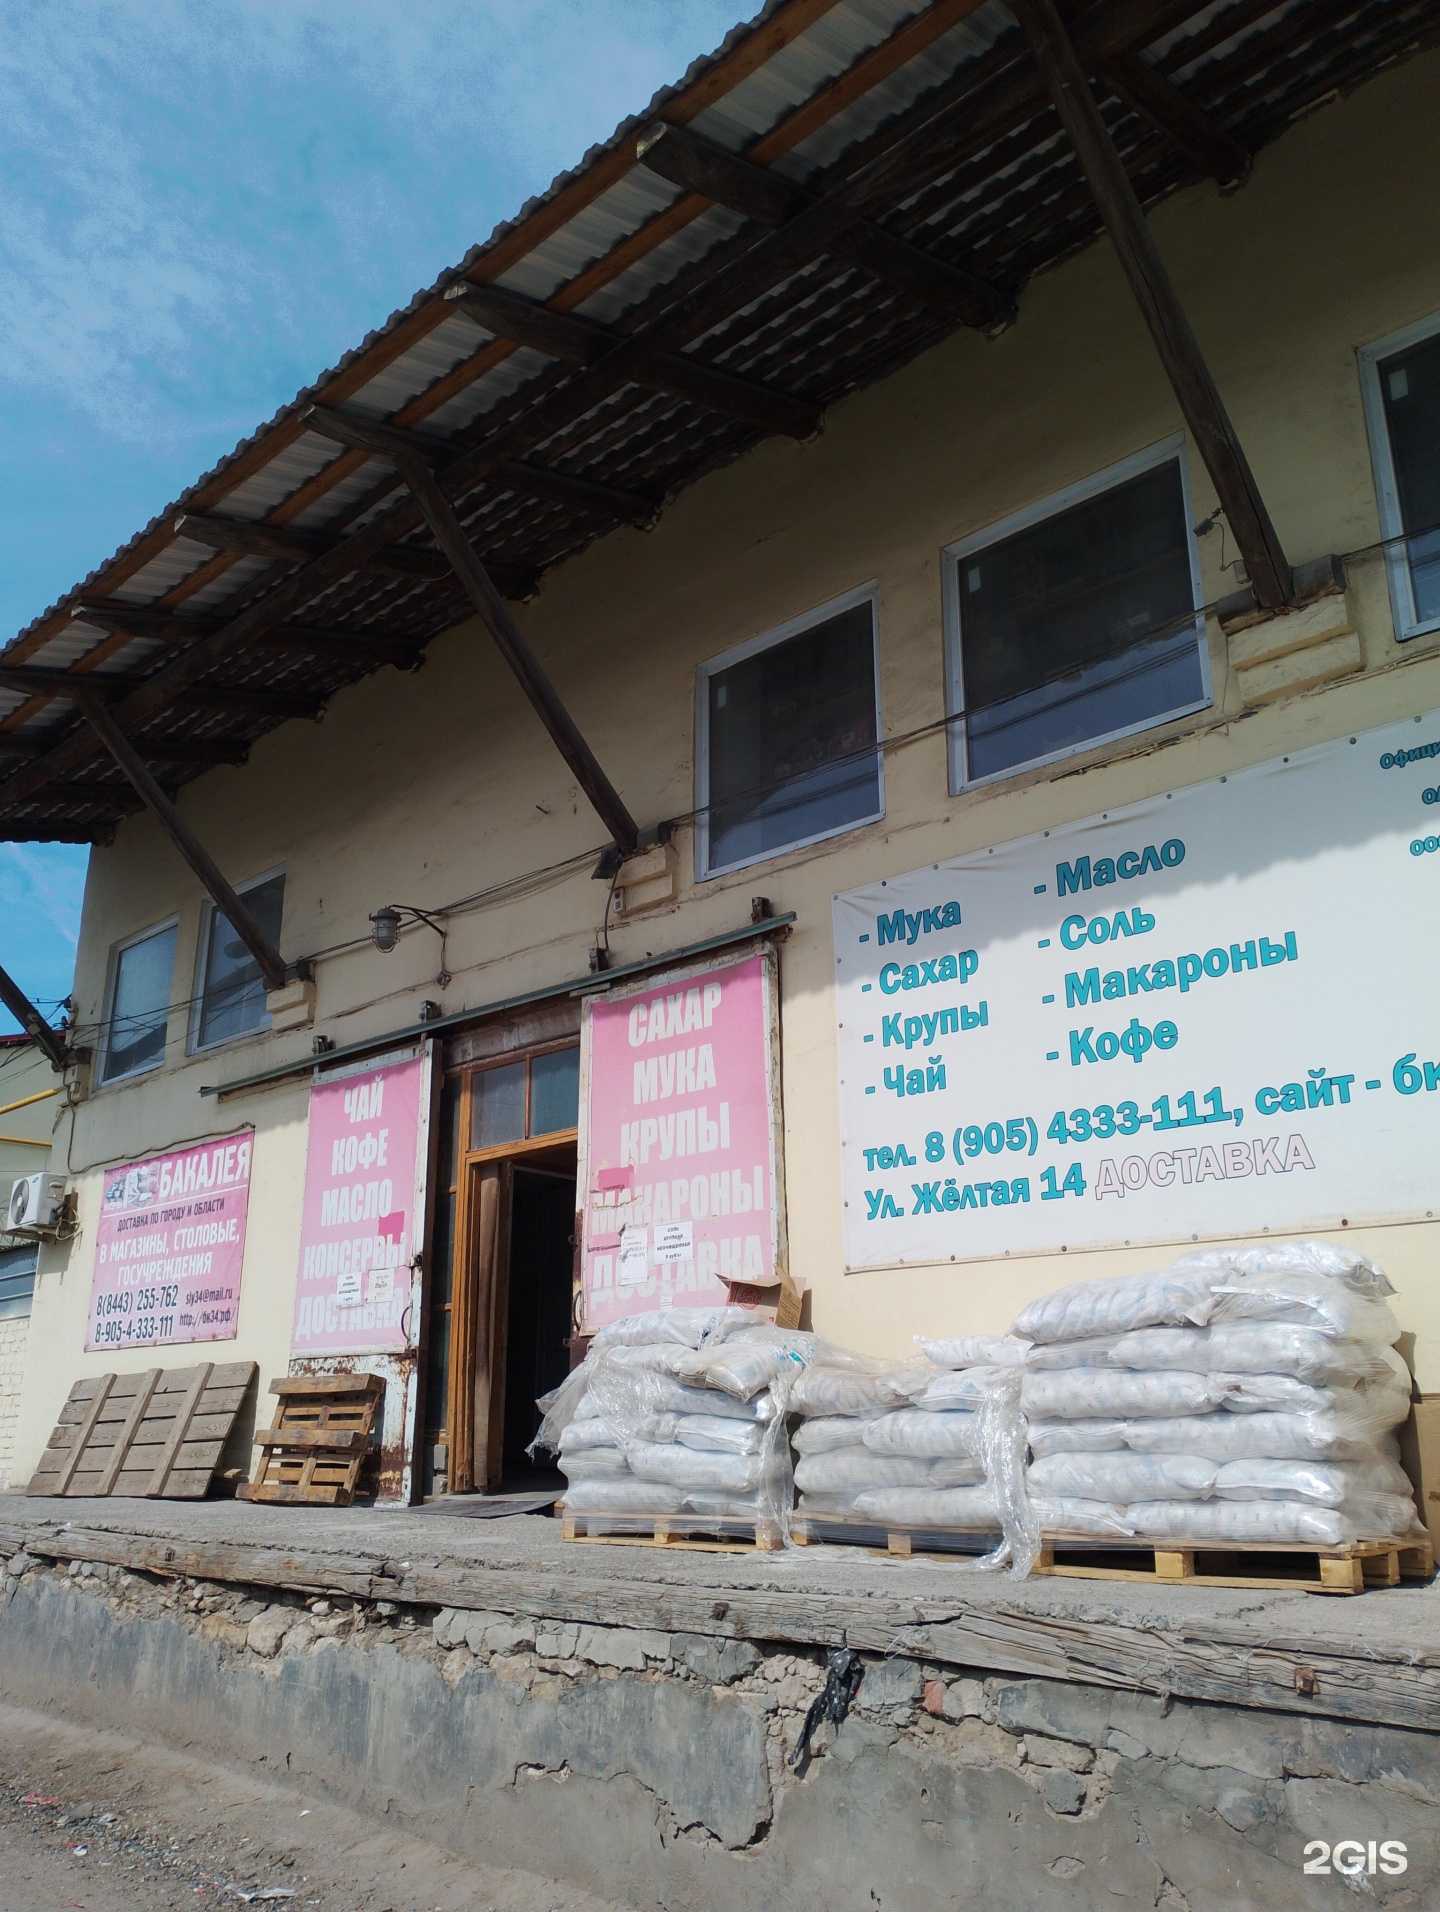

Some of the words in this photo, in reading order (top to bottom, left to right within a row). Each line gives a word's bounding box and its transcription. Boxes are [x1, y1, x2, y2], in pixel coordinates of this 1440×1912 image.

[1055, 838, 1186, 898] Масло
[876, 900, 962, 946] Мука
[1059, 906, 1156, 951] Соль
[878, 949, 979, 995] Сахар
[1064, 931, 1298, 1009] Макароны
[628, 982, 722, 1048] САХАР
[881, 1000, 989, 1050] Крупы
[1068, 1017, 1179, 1067] Кофе
[344, 1073, 385, 1123] ЧАЙ
[632, 1043, 717, 1105] МУКА
[883, 1055, 947, 1098] Чай
[619, 1102, 731, 1168] КРУПЫ
[863, 1143, 917, 1172] тел.
[924, 1130, 946, 1163] 8
[952, 1117, 1039, 1166] (905)
[1046, 1086, 1244, 1145] 4333-111,
[1254, 1067, 1355, 1116] сайт
[159, 1141, 251, 1199] БАКАЛЕЯ
[331, 1128, 389, 1176] КОФЕ
[864, 1188, 905, 1221] Ул.
[911, 1178, 1031, 1215] Жёлтая
[1039, 1162, 1088, 1201] 14
[1095, 1133, 1316, 1201] ДОСТАВКА
[117, 1214, 149, 1233] ДОСТАВКА
[150, 1212, 160, 1226] ПО
[160, 1205, 186, 1223] ГОРОДУ
[187, 1204, 193, 1216] И
[193, 1198, 226, 1215] ОБЛАСТИ
[321, 1178, 393, 1227] МАСЛО
[99, 1244, 108, 1264] В
[110, 1231, 170, 1264] МАГАЗИНЫ,
[173, 1218, 241, 1251] СТОЛОВЫЕ,
[303, 1231, 407, 1281] КОНСЕРВЫ
[117, 1252, 214, 1286] ГОСУЧРЕЖДЕНИЯ
[96, 1290, 133, 1318] 8(8443)
[136, 1284, 179, 1312] 255-762
[95, 1314, 174, 1344] 8-905-4-333-111
